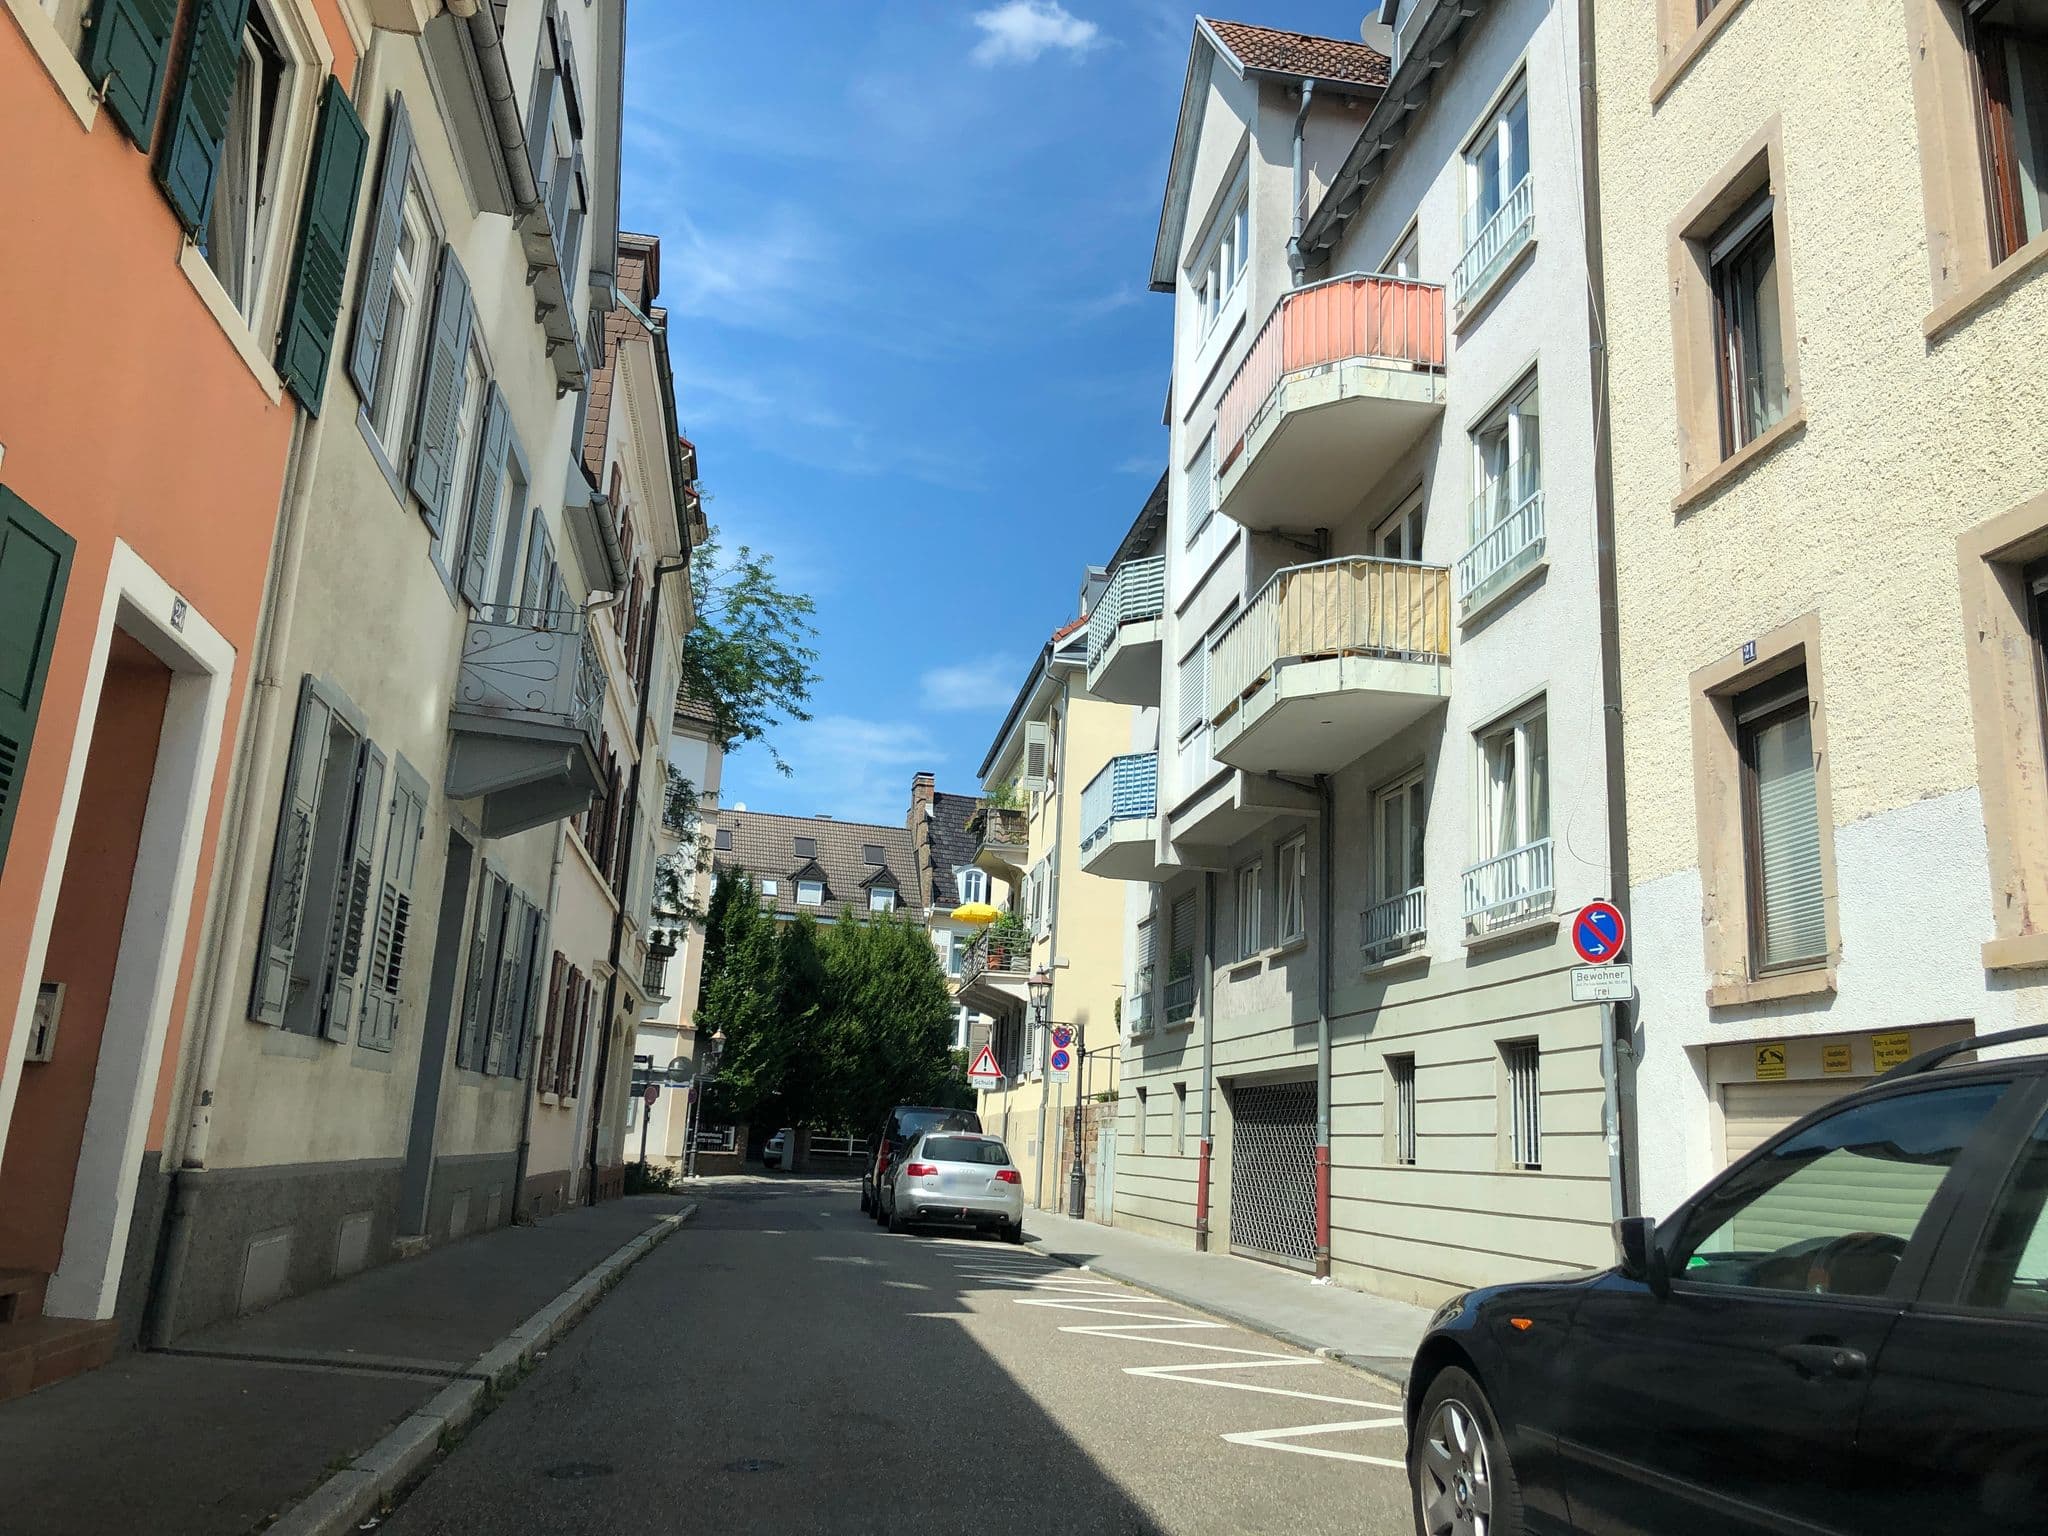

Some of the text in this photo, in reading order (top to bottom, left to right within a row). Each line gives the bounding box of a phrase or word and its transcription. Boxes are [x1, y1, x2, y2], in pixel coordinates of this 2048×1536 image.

[1743, 642, 1755, 659] 21
[1576, 971, 1625, 982] Bewohner
[1594, 987, 1610, 996] frei
